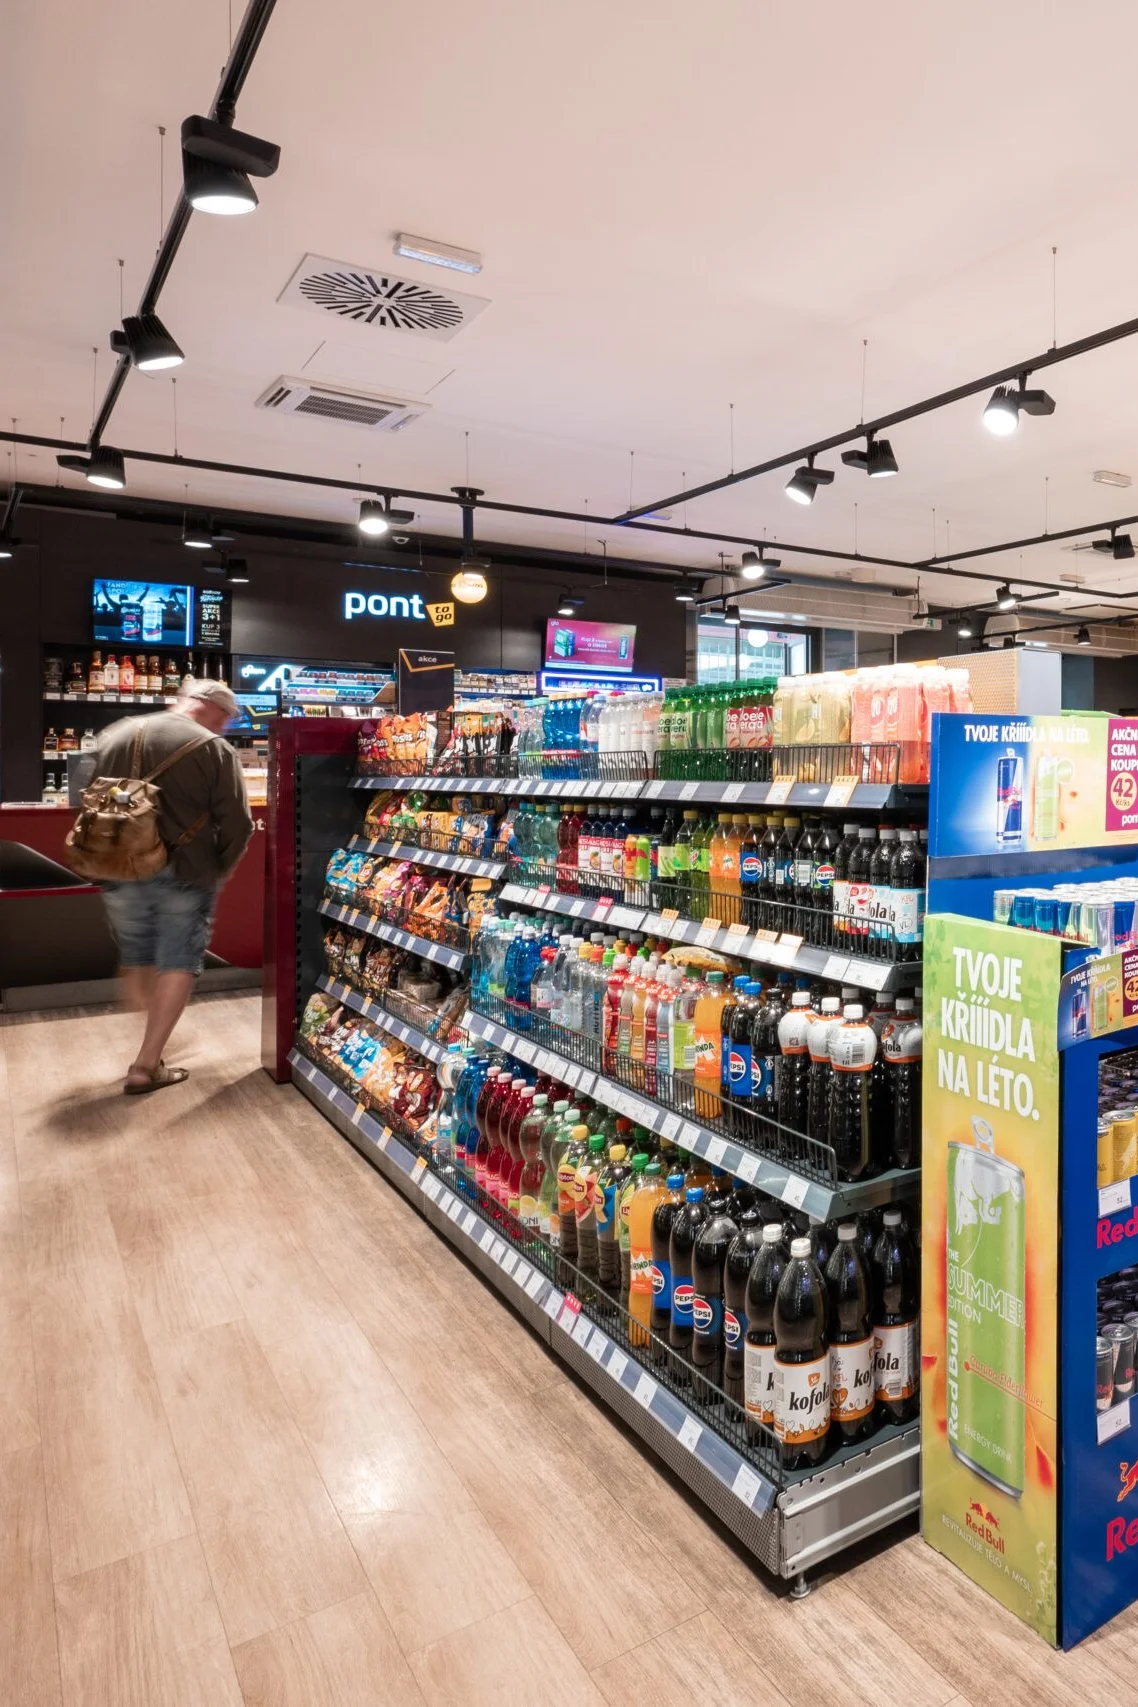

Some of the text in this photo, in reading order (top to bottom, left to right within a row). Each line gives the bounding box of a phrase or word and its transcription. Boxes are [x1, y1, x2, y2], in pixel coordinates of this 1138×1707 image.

[345, 592, 426, 619] pont
[435, 613, 452, 623] go
[964, 724, 999, 743] TVOJE
[1110, 743, 1135, 756] CENA
[1110, 758, 1138, 772] KOUPI
[1112, 776, 1133, 798] 42
[871, 902, 887, 918] ola
[952, 947, 1023, 1002] TVOJE
[1070, 971, 1087, 984] TVOJE
[941, 991, 1036, 1062] KŘÍÍÍDLA
[730, 1062, 744, 1071] EPSI
[937, 1048, 1040, 1121] NA LÉTO.
[1096, 1206, 1138, 1248] Red
[948, 1249, 959, 1262] THE
[653, 1277, 663, 1285] PSI
[675, 1294, 695, 1302] PEPS
[947, 1263, 1024, 1329] SUMMER
[695, 1310, 711, 1318] EPSI
[872, 1352, 901, 1373] fola
[948, 1318, 958, 1440] Red Bull
[964, 1423, 991, 1450] ENERGY
[965, 1512, 1005, 1554] Red Bull
[1004, 1567, 1010, 1576] A
